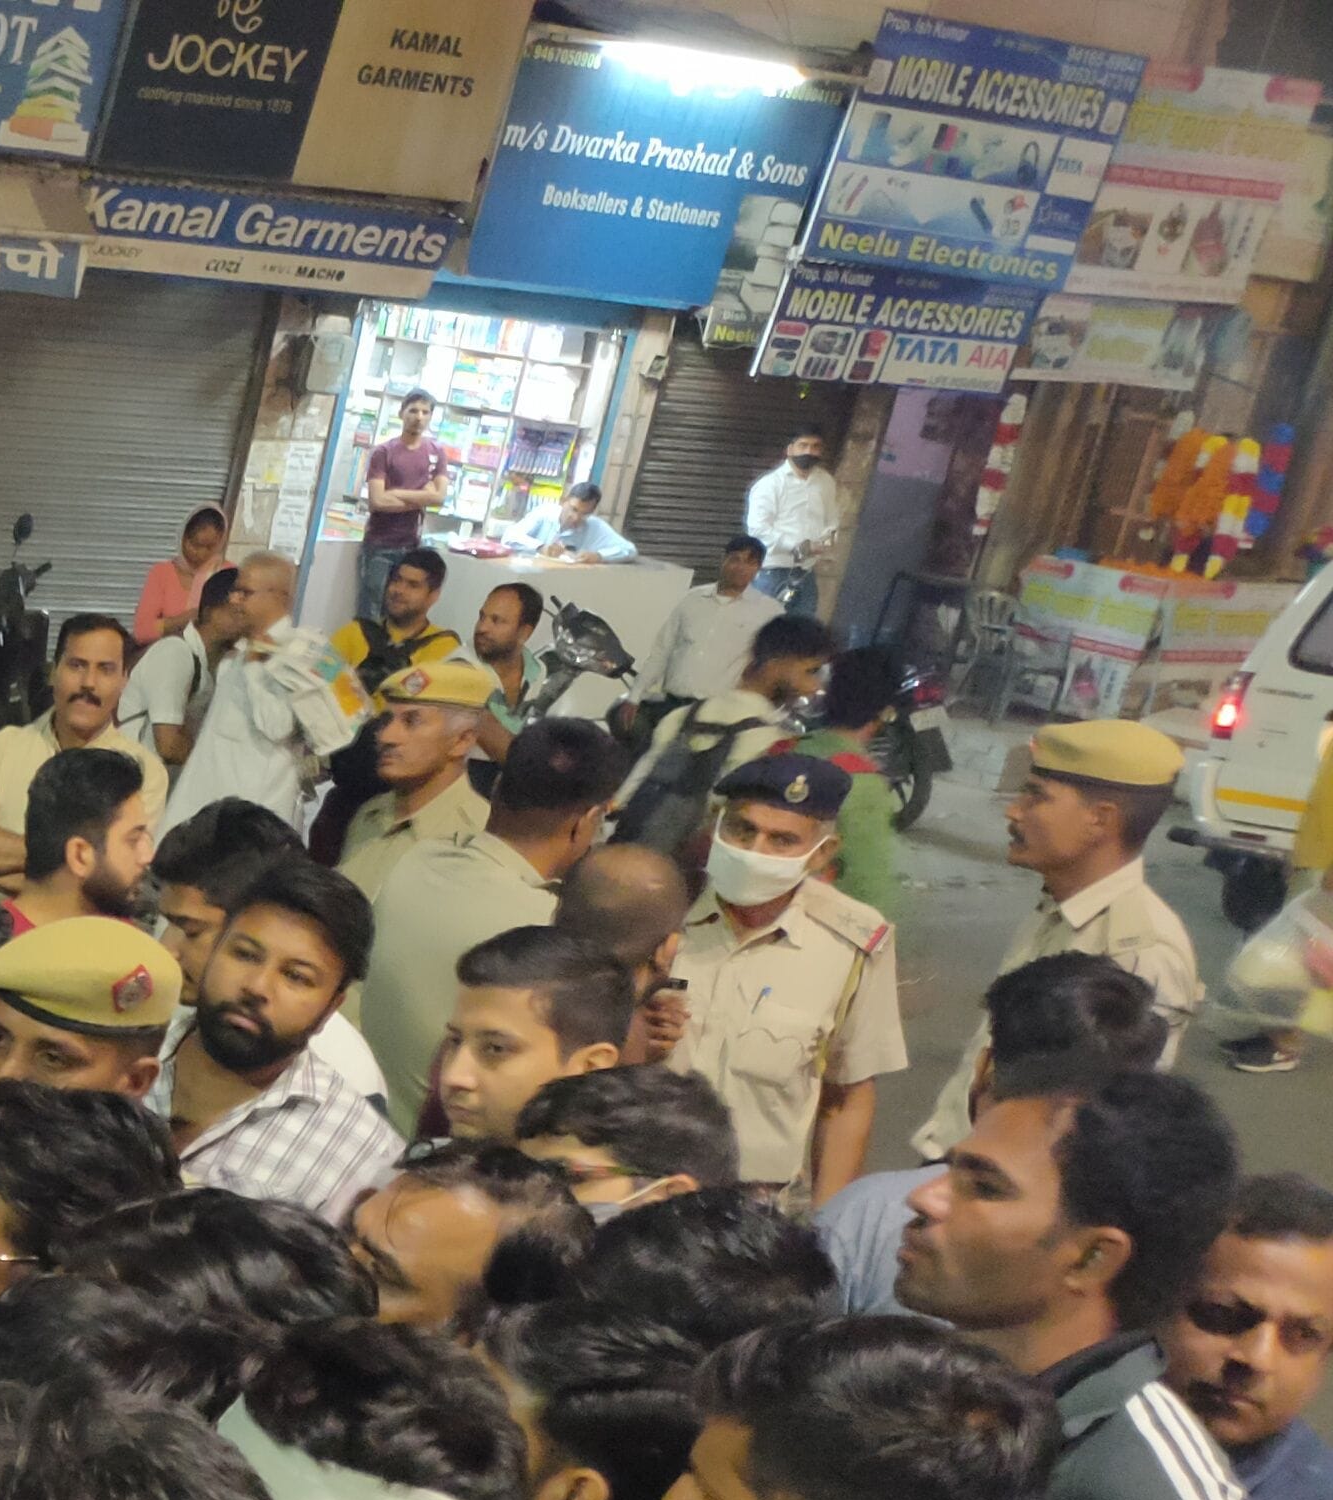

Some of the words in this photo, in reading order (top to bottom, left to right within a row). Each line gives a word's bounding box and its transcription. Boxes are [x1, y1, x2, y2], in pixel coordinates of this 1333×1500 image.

[147, 33, 308, 85] JOCKEY
[390, 27, 464, 58] KAMAL
[357, 64, 475, 98] GARMENTS
[889, 56, 973, 107] MOBILE
[967, 68, 1106, 130] ACCESSORIES
[502, 122, 549, 151] m/s
[550, 125, 644, 164] Dwarka
[641, 137, 736, 178] Prashad
[736, 152, 755, 180] &
[756, 155, 808, 187] Sons
[84, 186, 230, 239] Kamal
[235, 203, 447, 263] Garments
[542, 184, 627, 216] Booksellers
[630, 196, 643, 219] &
[646, 199, 722, 228] Stationers
[818, 223, 901, 258] Neelu
[907, 236, 1059, 282] Electronics
[786, 287, 876, 325] MOBILE
[873, 297, 1025, 339] ACCESSORIES
[895, 338, 960, 366] TATA
[965, 345, 1010, 371] AIA
